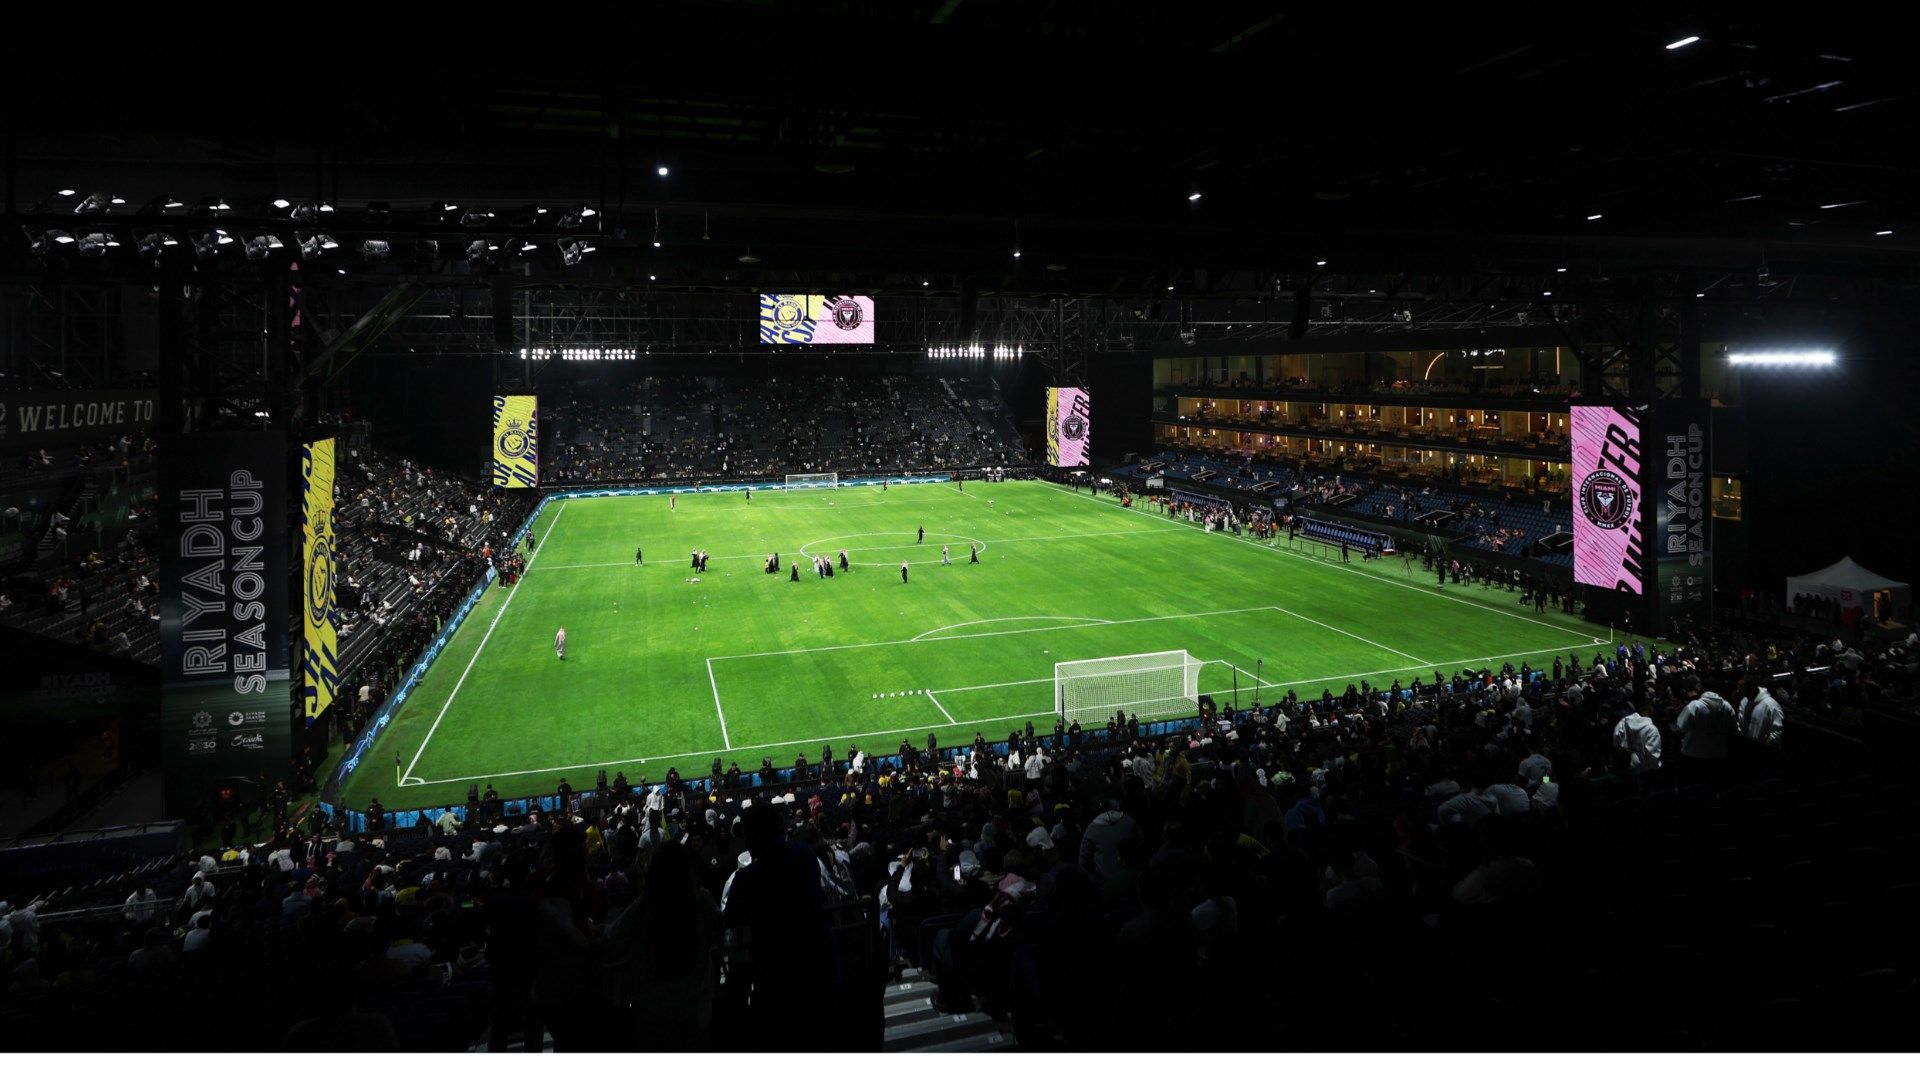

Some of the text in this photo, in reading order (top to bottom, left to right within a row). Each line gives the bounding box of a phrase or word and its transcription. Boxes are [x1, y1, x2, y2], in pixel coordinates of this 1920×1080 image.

[18, 401, 126, 433] WELCOME
[134, 399, 153, 422] TO
[1688, 422, 1704, 470] CUP
[230, 469, 265, 541] CUP
[1580, 496, 1589, 514] CLUB
[1581, 471, 1622, 495] INTERNACIONAL
[1622, 484, 1630, 494] DE
[1666, 434, 1687, 553] RIYADH
[1688, 472, 1704, 567] SEASON
[181, 488, 227, 676] RIYADH
[231, 545, 266, 694] SEASON
